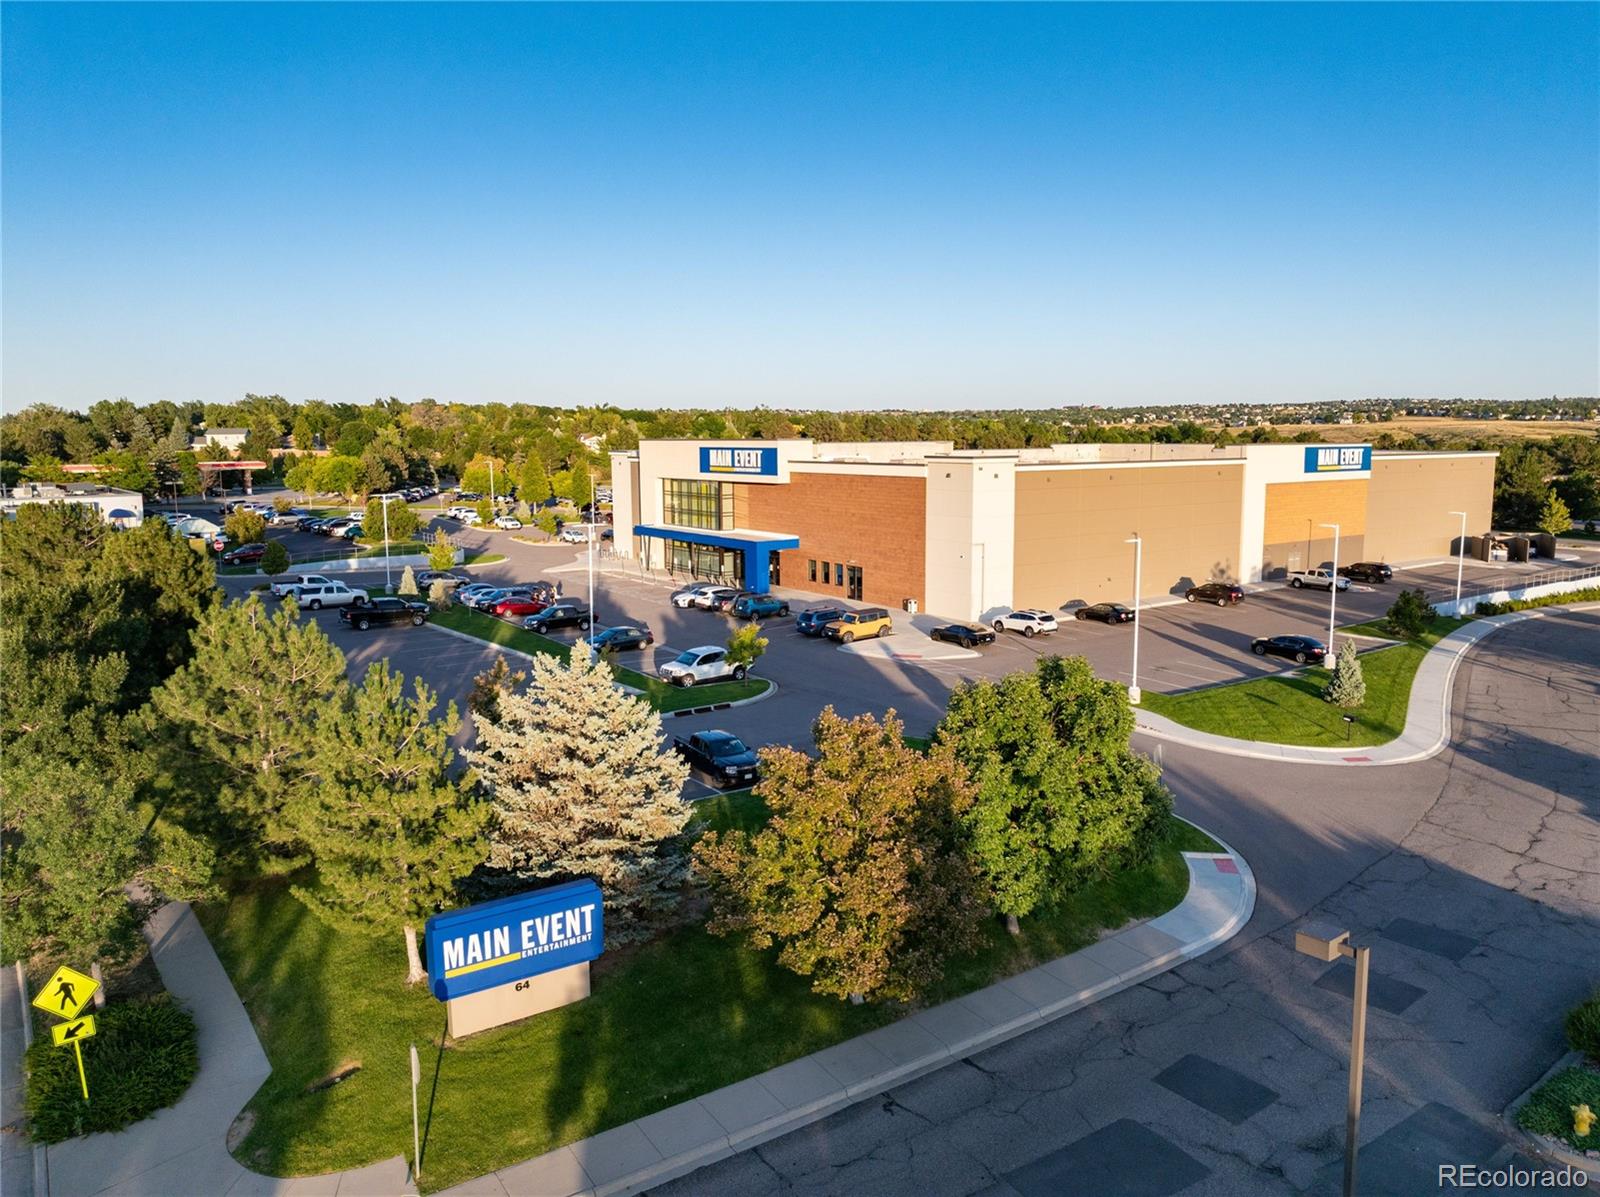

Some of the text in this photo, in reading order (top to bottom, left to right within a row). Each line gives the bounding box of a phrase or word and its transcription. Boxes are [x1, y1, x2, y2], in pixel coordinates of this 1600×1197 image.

[709, 449, 763, 468] MAIN EVENT
[1318, 448, 1364, 465] MAIN EVENT
[442, 903, 595, 971] MAIN EVENT
[521, 932, 592, 959] ENTERTAINMENT
[514, 980, 530, 992] 64
